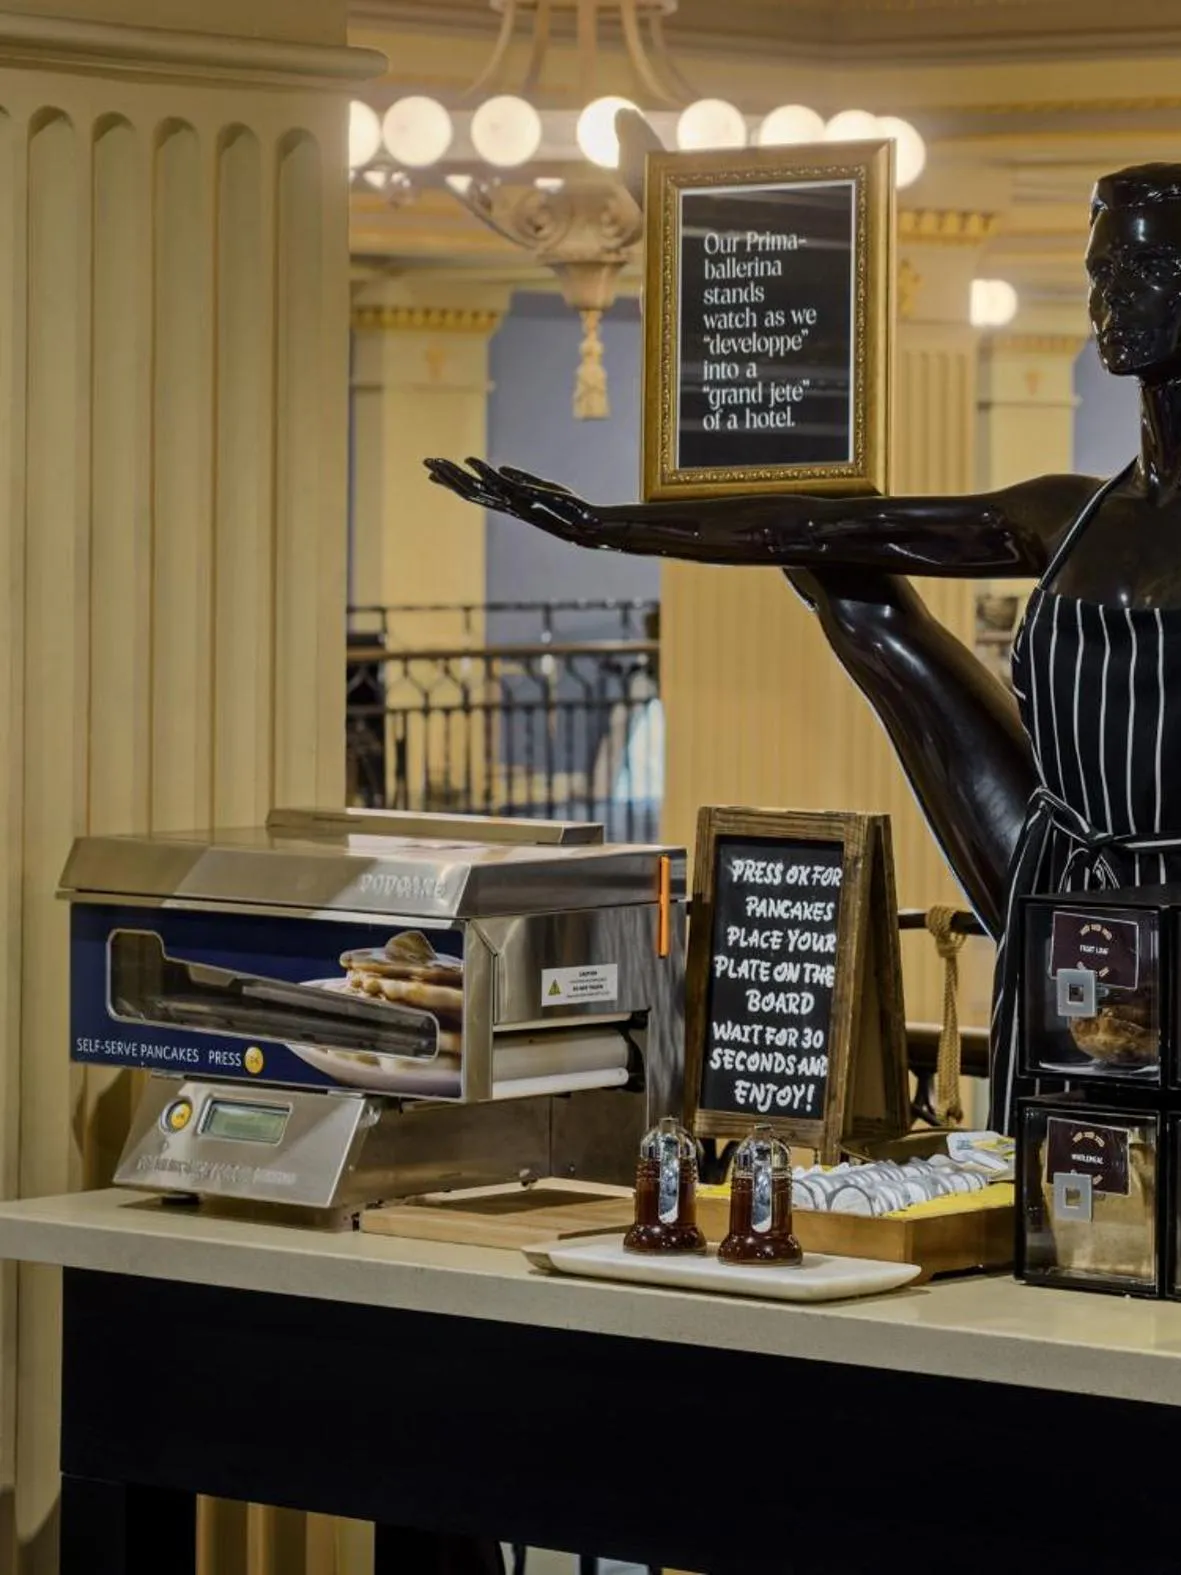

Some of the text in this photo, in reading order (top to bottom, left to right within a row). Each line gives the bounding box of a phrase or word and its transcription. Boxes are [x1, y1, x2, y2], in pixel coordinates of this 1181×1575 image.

[704, 231, 807, 254] Our Prima-
[704, 256, 782, 279] ballerina
[703, 281, 765, 304] stands
[703, 306, 817, 330] watch as we
[703, 360, 758, 380] into a
[702, 381, 763, 410] “grand
[703, 405, 796, 431] of a hotel.
[729, 858, 843, 886] PRESS OK FOR
[745, 895, 835, 922] PANCAKES
[727, 925, 837, 953] PLACE YOUR
[714, 954, 836, 988] PLATE ON THE
[745, 988, 815, 1015] BOARD
[712, 1020, 825, 1049] WAIT FOR 30
[76, 1037, 138, 1057] SELF-SERVE
[140, 1043, 200, 1063] PANCAKES
[208, 1050, 242, 1067] PRESS
[709, 1047, 829, 1077] SECONDS AND
[734, 1079, 815, 1113] ENJOY!
